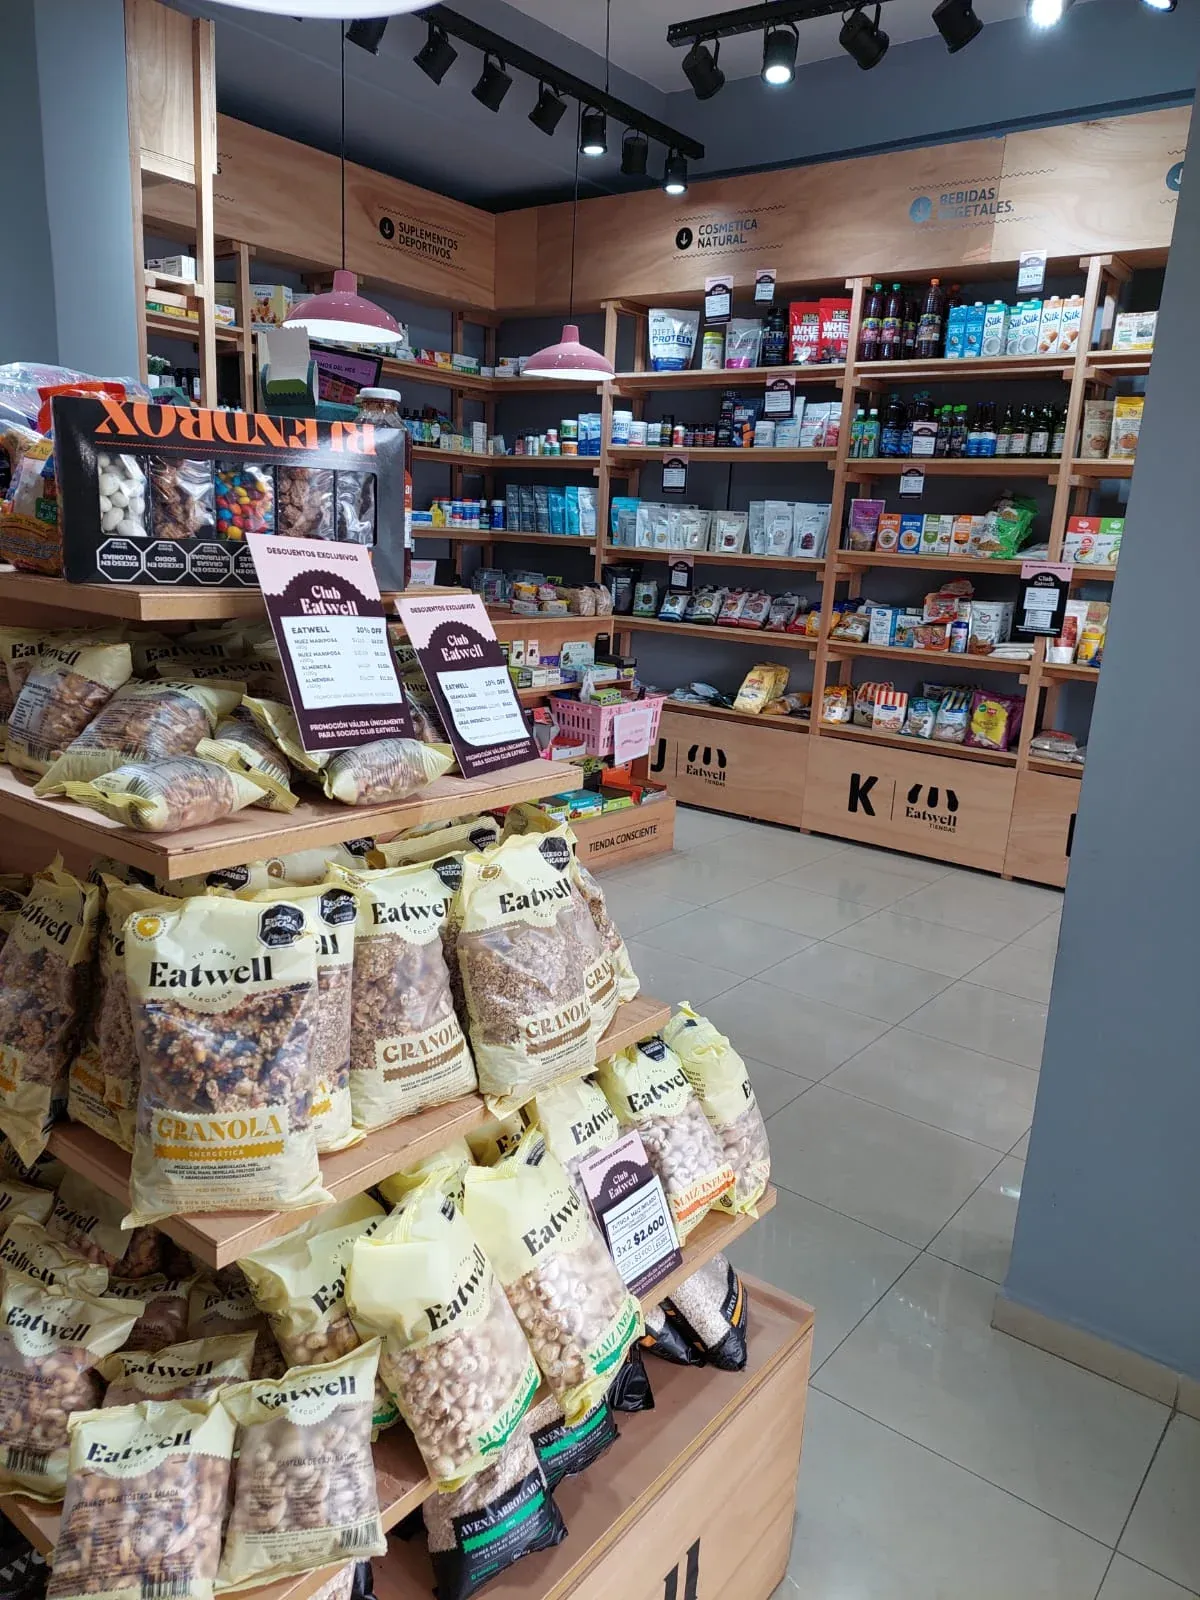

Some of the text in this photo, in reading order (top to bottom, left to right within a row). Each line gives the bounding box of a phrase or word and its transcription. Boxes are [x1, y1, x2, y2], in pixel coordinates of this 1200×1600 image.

[940, 187, 996, 205] BEBIDAS
[938, 200, 1014, 220] GETALES.
[398, 222, 459, 250] SUPLEMENTOS
[698, 219, 758, 235] COSMETICA
[985, 316, 1002, 327] Silk
[1021, 314, 1039, 325] Silk
[1042, 313, 1059, 324] Silk
[1062, 310, 1080, 322] Silk
[793, 325, 819, 334] WHE
[821, 331, 849, 339] PROTE
[822, 322, 849, 331] WHE
[652, 334, 693, 345] PROTEIN
[792, 334, 819, 342] PROTE
[266, 546, 359, 562] DESCUENTOS EXCLUSIVOS
[311, 585, 341, 600] Club
[299, 598, 359, 616] Eatwell
[410, 603, 476, 614] DESCUENTOS EXCLUSIVOS
[291, 626, 330, 634] EATWELL
[447, 634, 469, 646] Club
[145, 643, 225, 662] Eatwell
[441, 643, 484, 662] Eatwell
[192, 660, 275, 677] Eatwell
[445, 683, 469, 691] EATWELL
[318, 731, 336, 739] PARA
[336, 729, 359, 737] SOCIOS
[650, 738, 667, 773] J
[686, 764, 726, 782] Eatwell
[704, 778, 726, 787] TIENDAS
[847, 773, 879, 816] K
[905, 806, 957, 827] Eatwell
[929, 823, 956, 833] TIENDAS
[589, 824, 657, 852] TIENDA CONSCIENTE
[499, 877, 571, 915] Eatwell
[191, 948, 237, 961] TU SANA
[148, 955, 274, 988] Eatwell
[627, 1068, 690, 1113] Eatwel
[157, 1114, 282, 1142] GRANOLA
[570, 1106, 615, 1146] Eatw
[608, 1172, 639, 1201] Eatwell
[612, 1170, 629, 1185] Club
[701, 1168, 733, 1193] INFLAD
[521, 1185, 581, 1258] Eatwell
[611, 1215, 630, 1231] TUTUCA
[641, 1195, 657, 1213] INFLADO
[615, 1215, 665, 1258] 3x2 $2.600
[0, 1237, 56, 1286] Eatwell
[423, 1242, 486, 1332] Eatwell
[6, 1306, 91, 1342] Eatwell
[616, 1298, 635, 1336] INFLA
[121, 1358, 214, 1378] Eatwell
[256, 1375, 356, 1411] Eatwell
[86, 1428, 193, 1463] Eatwell
[537, 1426, 567, 1447] AVENA
[461, 1479, 542, 1537] AVENA ARROLLADA
